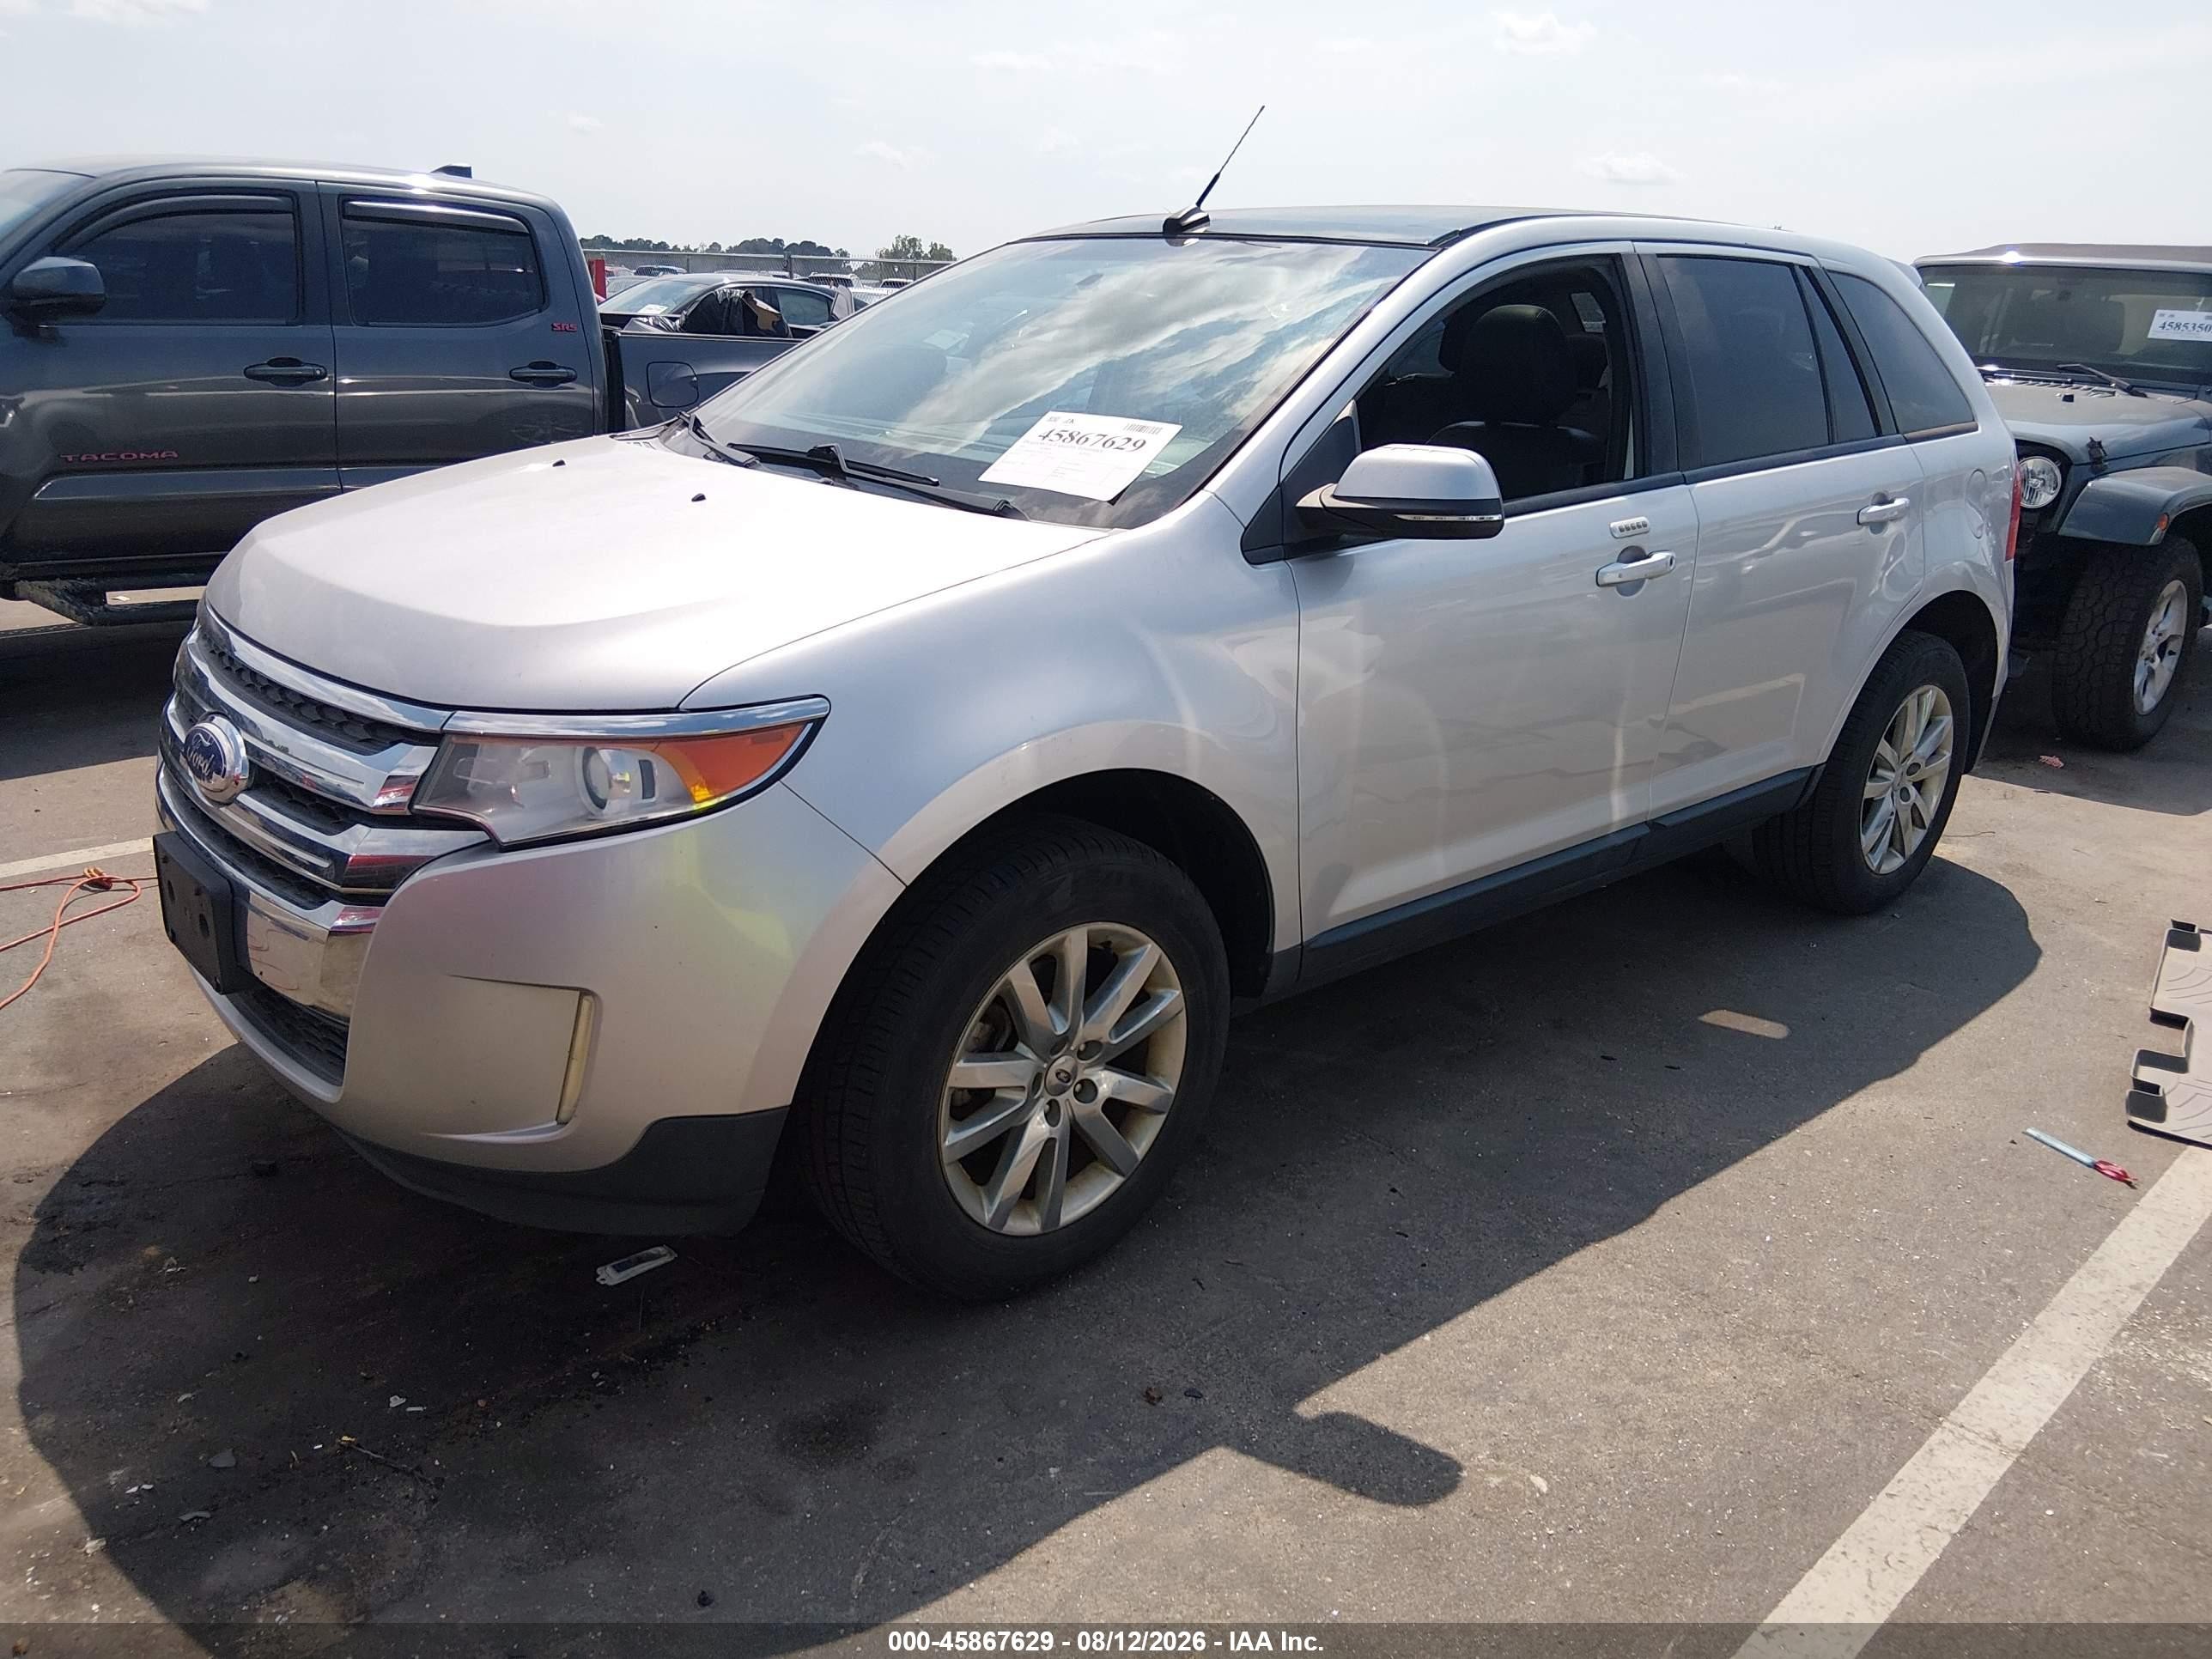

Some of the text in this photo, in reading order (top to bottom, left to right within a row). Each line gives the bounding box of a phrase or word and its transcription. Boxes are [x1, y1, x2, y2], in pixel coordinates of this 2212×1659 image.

[2159, 322, 2212, 333] 4585350
[1038, 428, 1146, 453] 45867629
[59, 451, 179, 462] TACOMA
[186, 732, 216, 777] Ford
